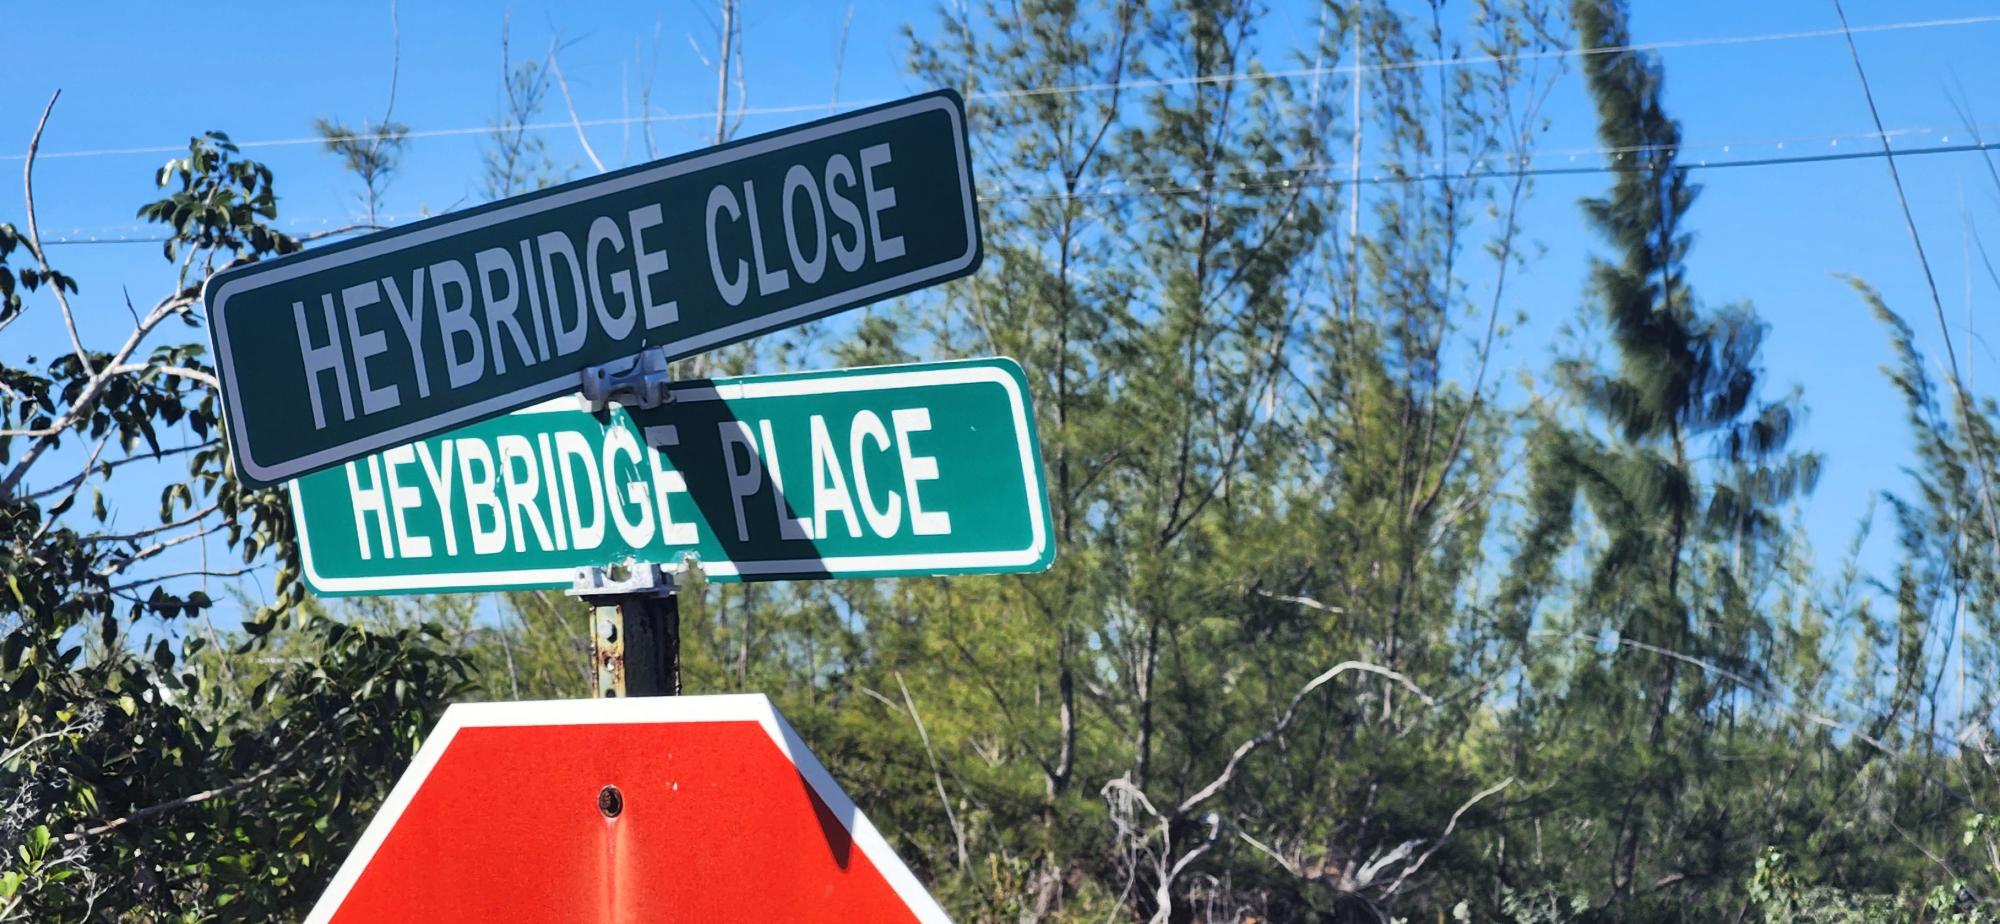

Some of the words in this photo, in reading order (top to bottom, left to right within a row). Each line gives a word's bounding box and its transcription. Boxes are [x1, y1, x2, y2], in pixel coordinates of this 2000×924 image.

[293, 204, 678, 429] HEYBRIDGE
[706, 144, 905, 305] CLOSE
[345, 425, 699, 559] HEYBRIDGE
[719, 408, 951, 542] PLACE
